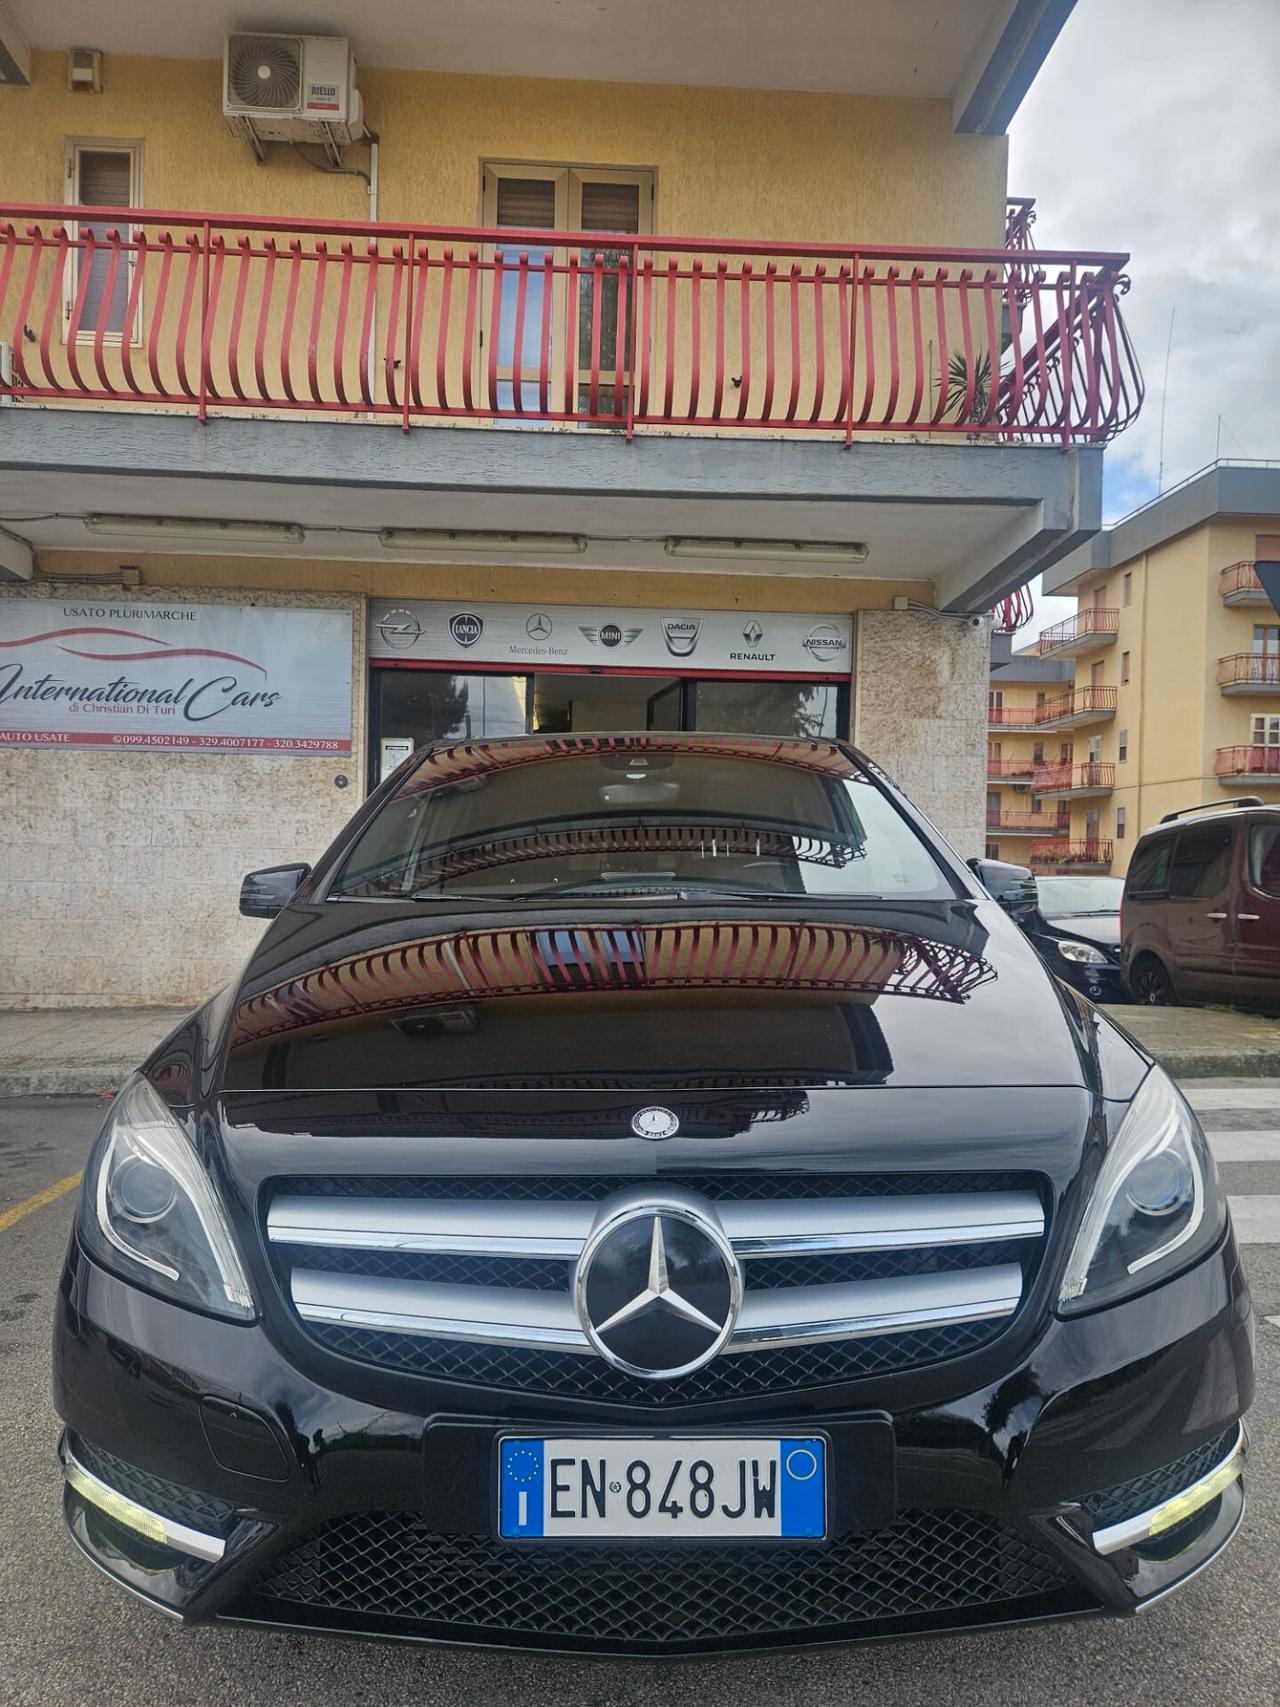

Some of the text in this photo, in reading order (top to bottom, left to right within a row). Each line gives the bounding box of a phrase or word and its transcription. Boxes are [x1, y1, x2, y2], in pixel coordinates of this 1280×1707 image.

[311, 86, 336, 96] RIELLO
[63, 607, 197, 621] USATO PLURIMARCHE
[455, 624, 478, 634] LANCIA
[667, 623, 696, 631] DACIA
[601, 631, 621, 641] MINI
[806, 638, 843, 647] NISSAN
[509, 646, 568, 656] Mercedes-Benz
[729, 652, 776, 661] RENAULT
[183, 676, 281, 721] Cars
[68, 702, 176, 715] di Christian Di Turi
[0, 731, 71, 743] AUTO USATE
[123, 735, 189, 746] 099.4502149
[199, 737, 264, 748] 329.4007177
[273, 739, 338, 750] 320.3429788
